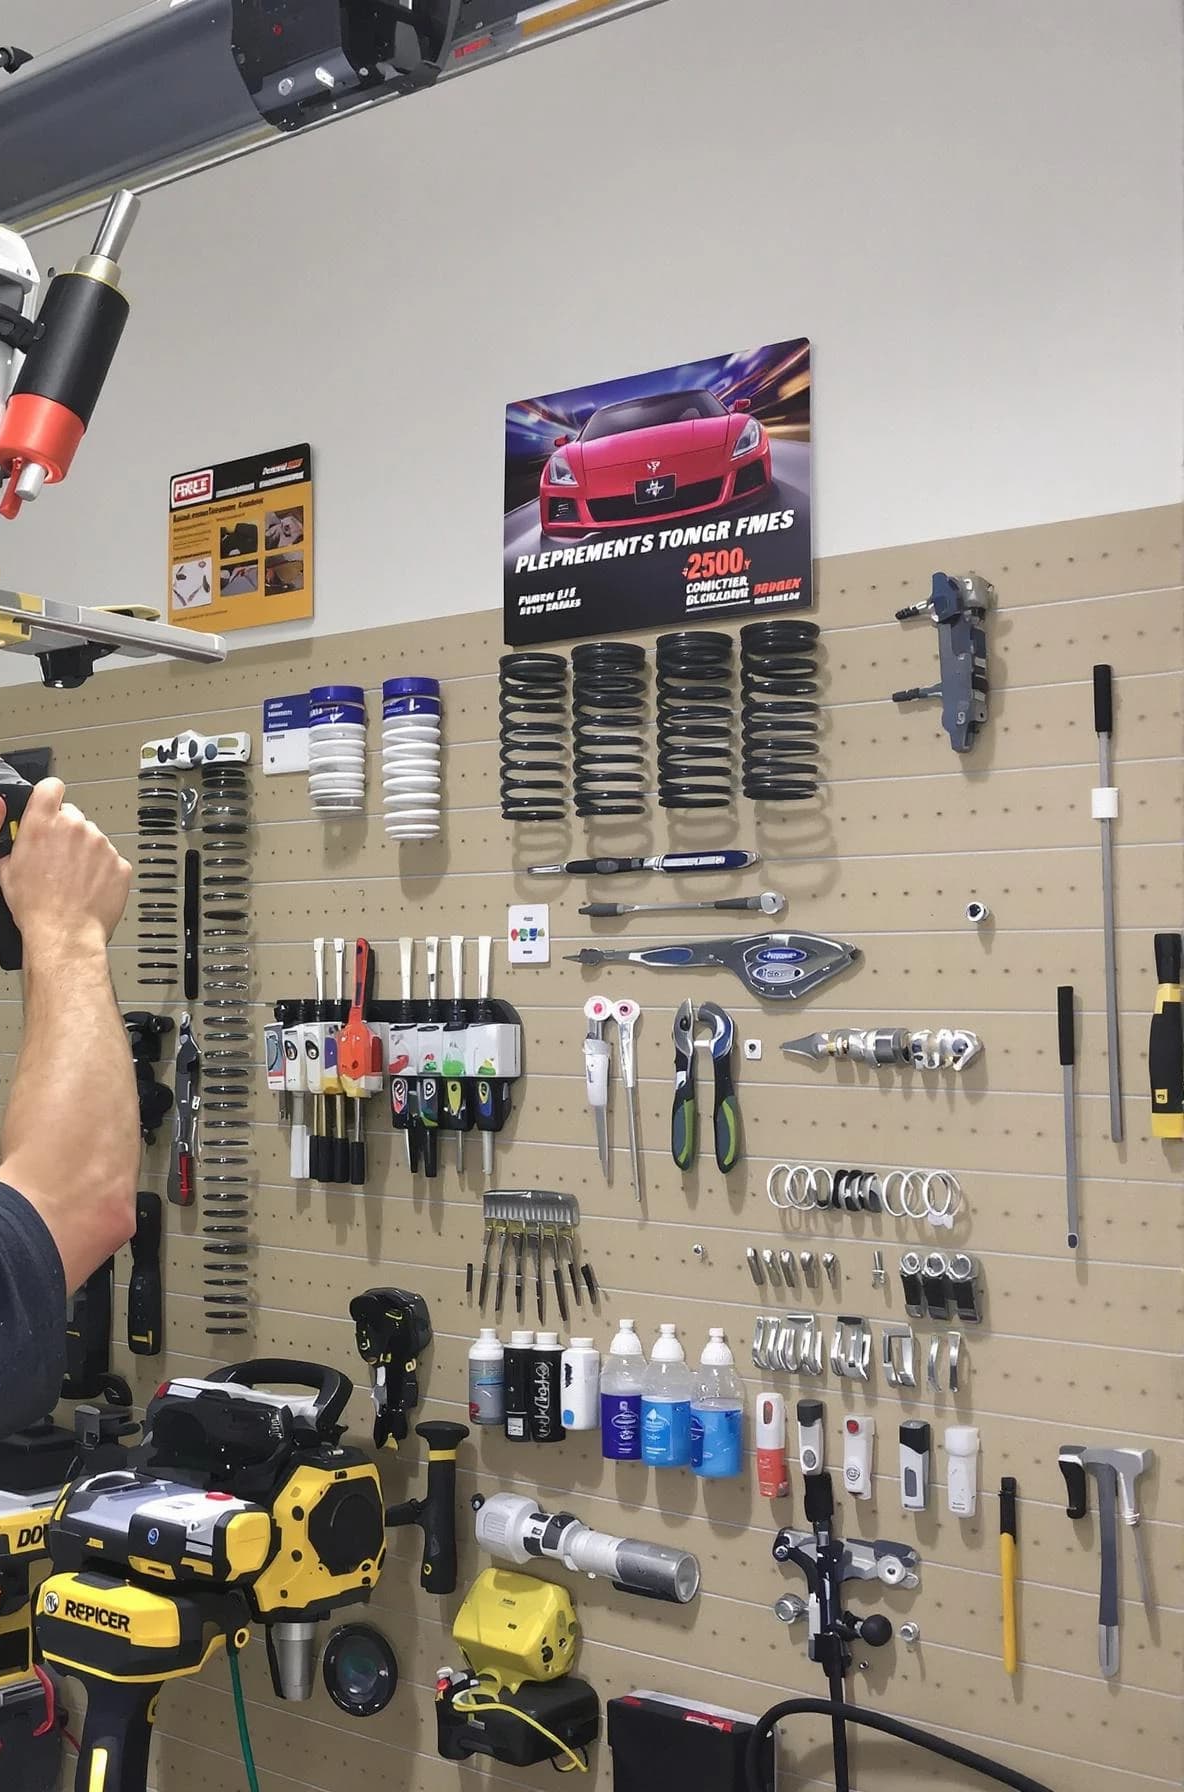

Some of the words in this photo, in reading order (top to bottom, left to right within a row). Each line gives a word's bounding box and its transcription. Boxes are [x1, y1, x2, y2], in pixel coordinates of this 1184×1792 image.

[515, 534, 654, 574] PLEPREMENTS
[659, 520, 731, 550] TONGR
[65, 1599, 131, 1632] REPICER
